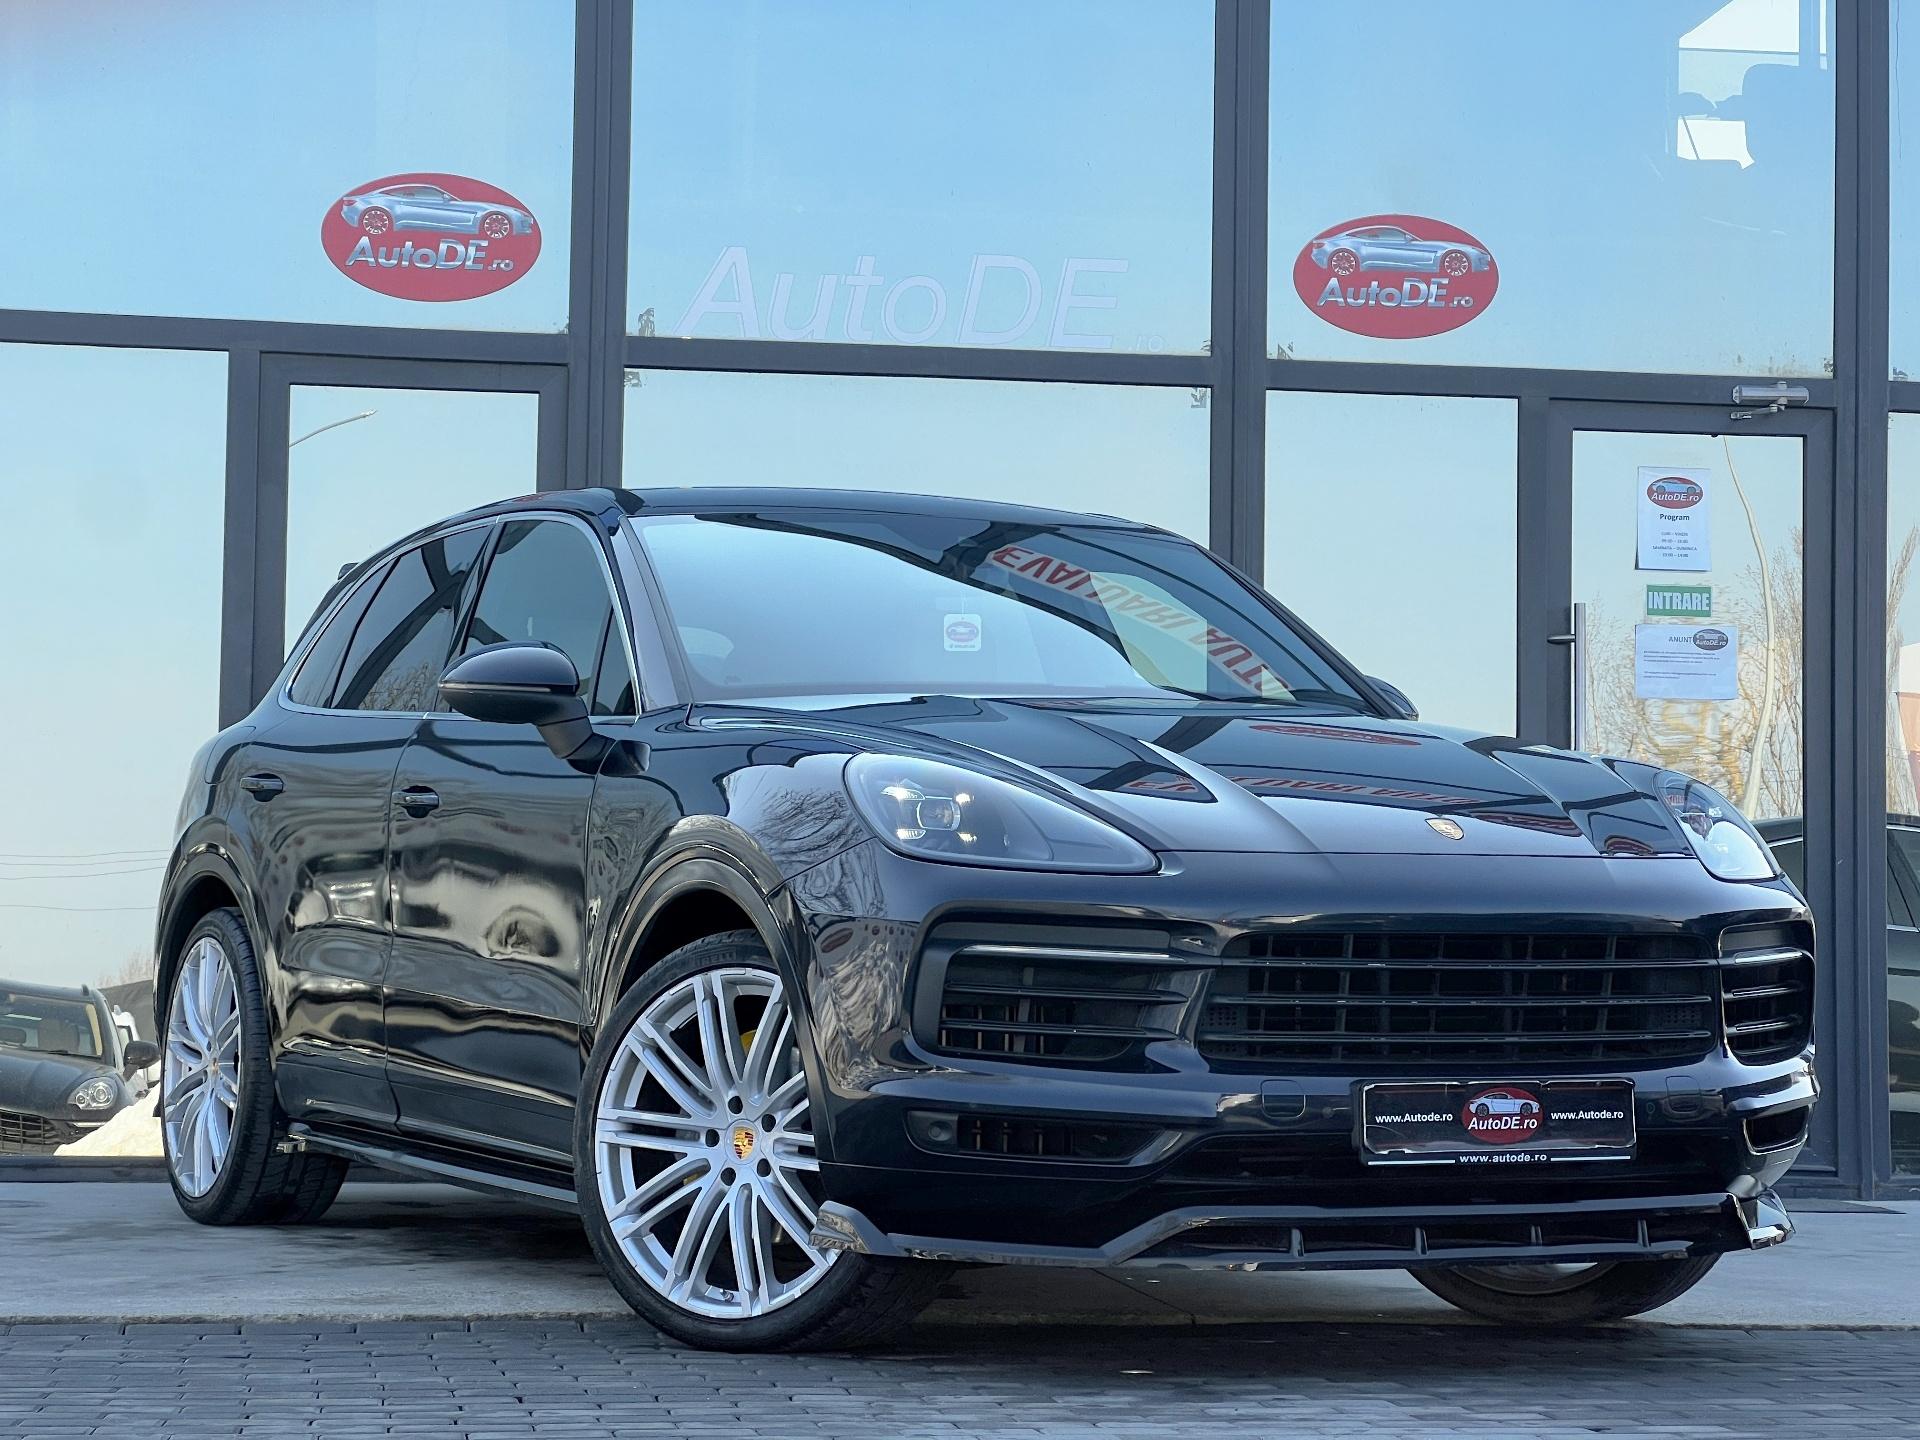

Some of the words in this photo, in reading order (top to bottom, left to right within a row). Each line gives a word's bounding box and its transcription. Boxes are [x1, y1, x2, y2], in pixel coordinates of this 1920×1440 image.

[1659, 513, 1690, 521] Program
[1648, 592, 1710, 611] INTRARE
[1375, 1112, 1454, 1124] www.Autode.ro
[1467, 1116, 1538, 1131] AutoDE.ro
[1550, 1109, 1624, 1120] www.Autode.ro
[1459, 1152, 1547, 1164] www.autode.ro
